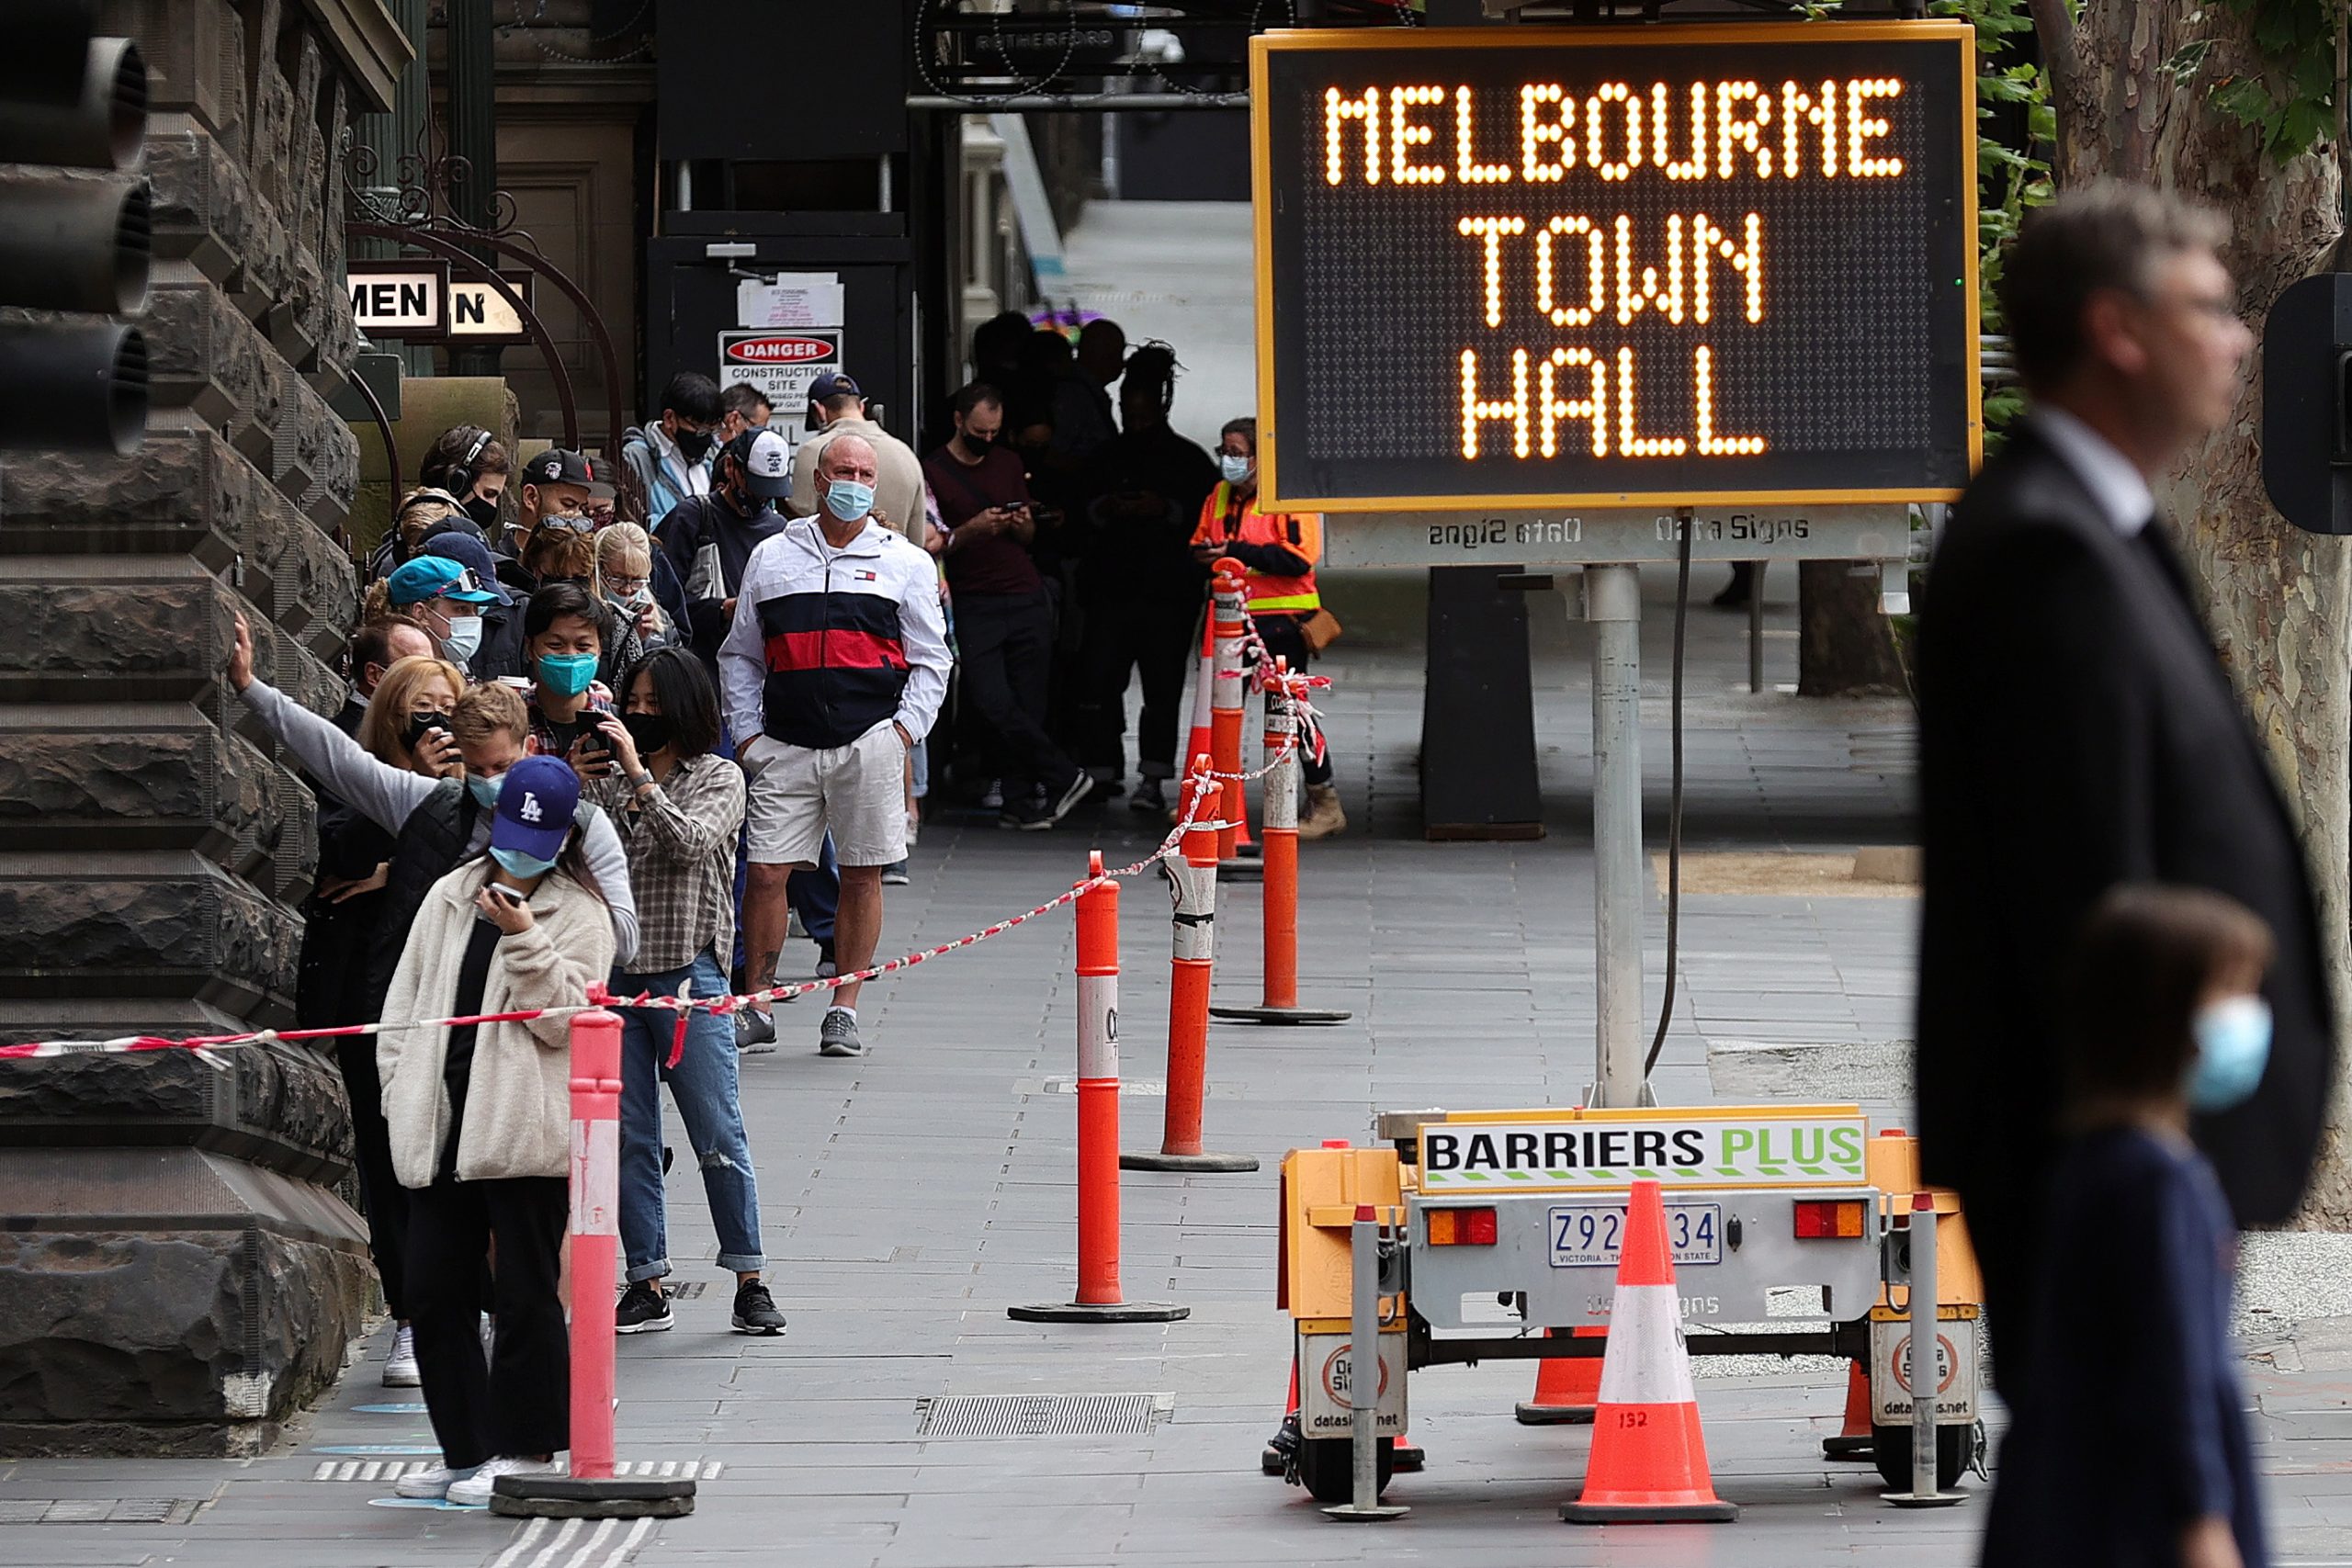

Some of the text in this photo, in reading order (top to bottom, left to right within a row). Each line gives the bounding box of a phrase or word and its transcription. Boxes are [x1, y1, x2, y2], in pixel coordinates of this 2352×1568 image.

[1326, 78, 1903, 186] MELBOURNE
[1458, 212, 1762, 328] TOWN
[742, 343, 818, 357] DANGER
[767, 379, 797, 390] SITE
[1462, 345, 1766, 460] HALL
[1731, 513, 1809, 544] Signs
[520, 792, 543, 822] LA
[1426, 1126, 1862, 1170] BARRIERS PLUS
[1559, 1255, 1601, 1263] VICTORIA
[1683, 1253, 1711, 1261] STATE
